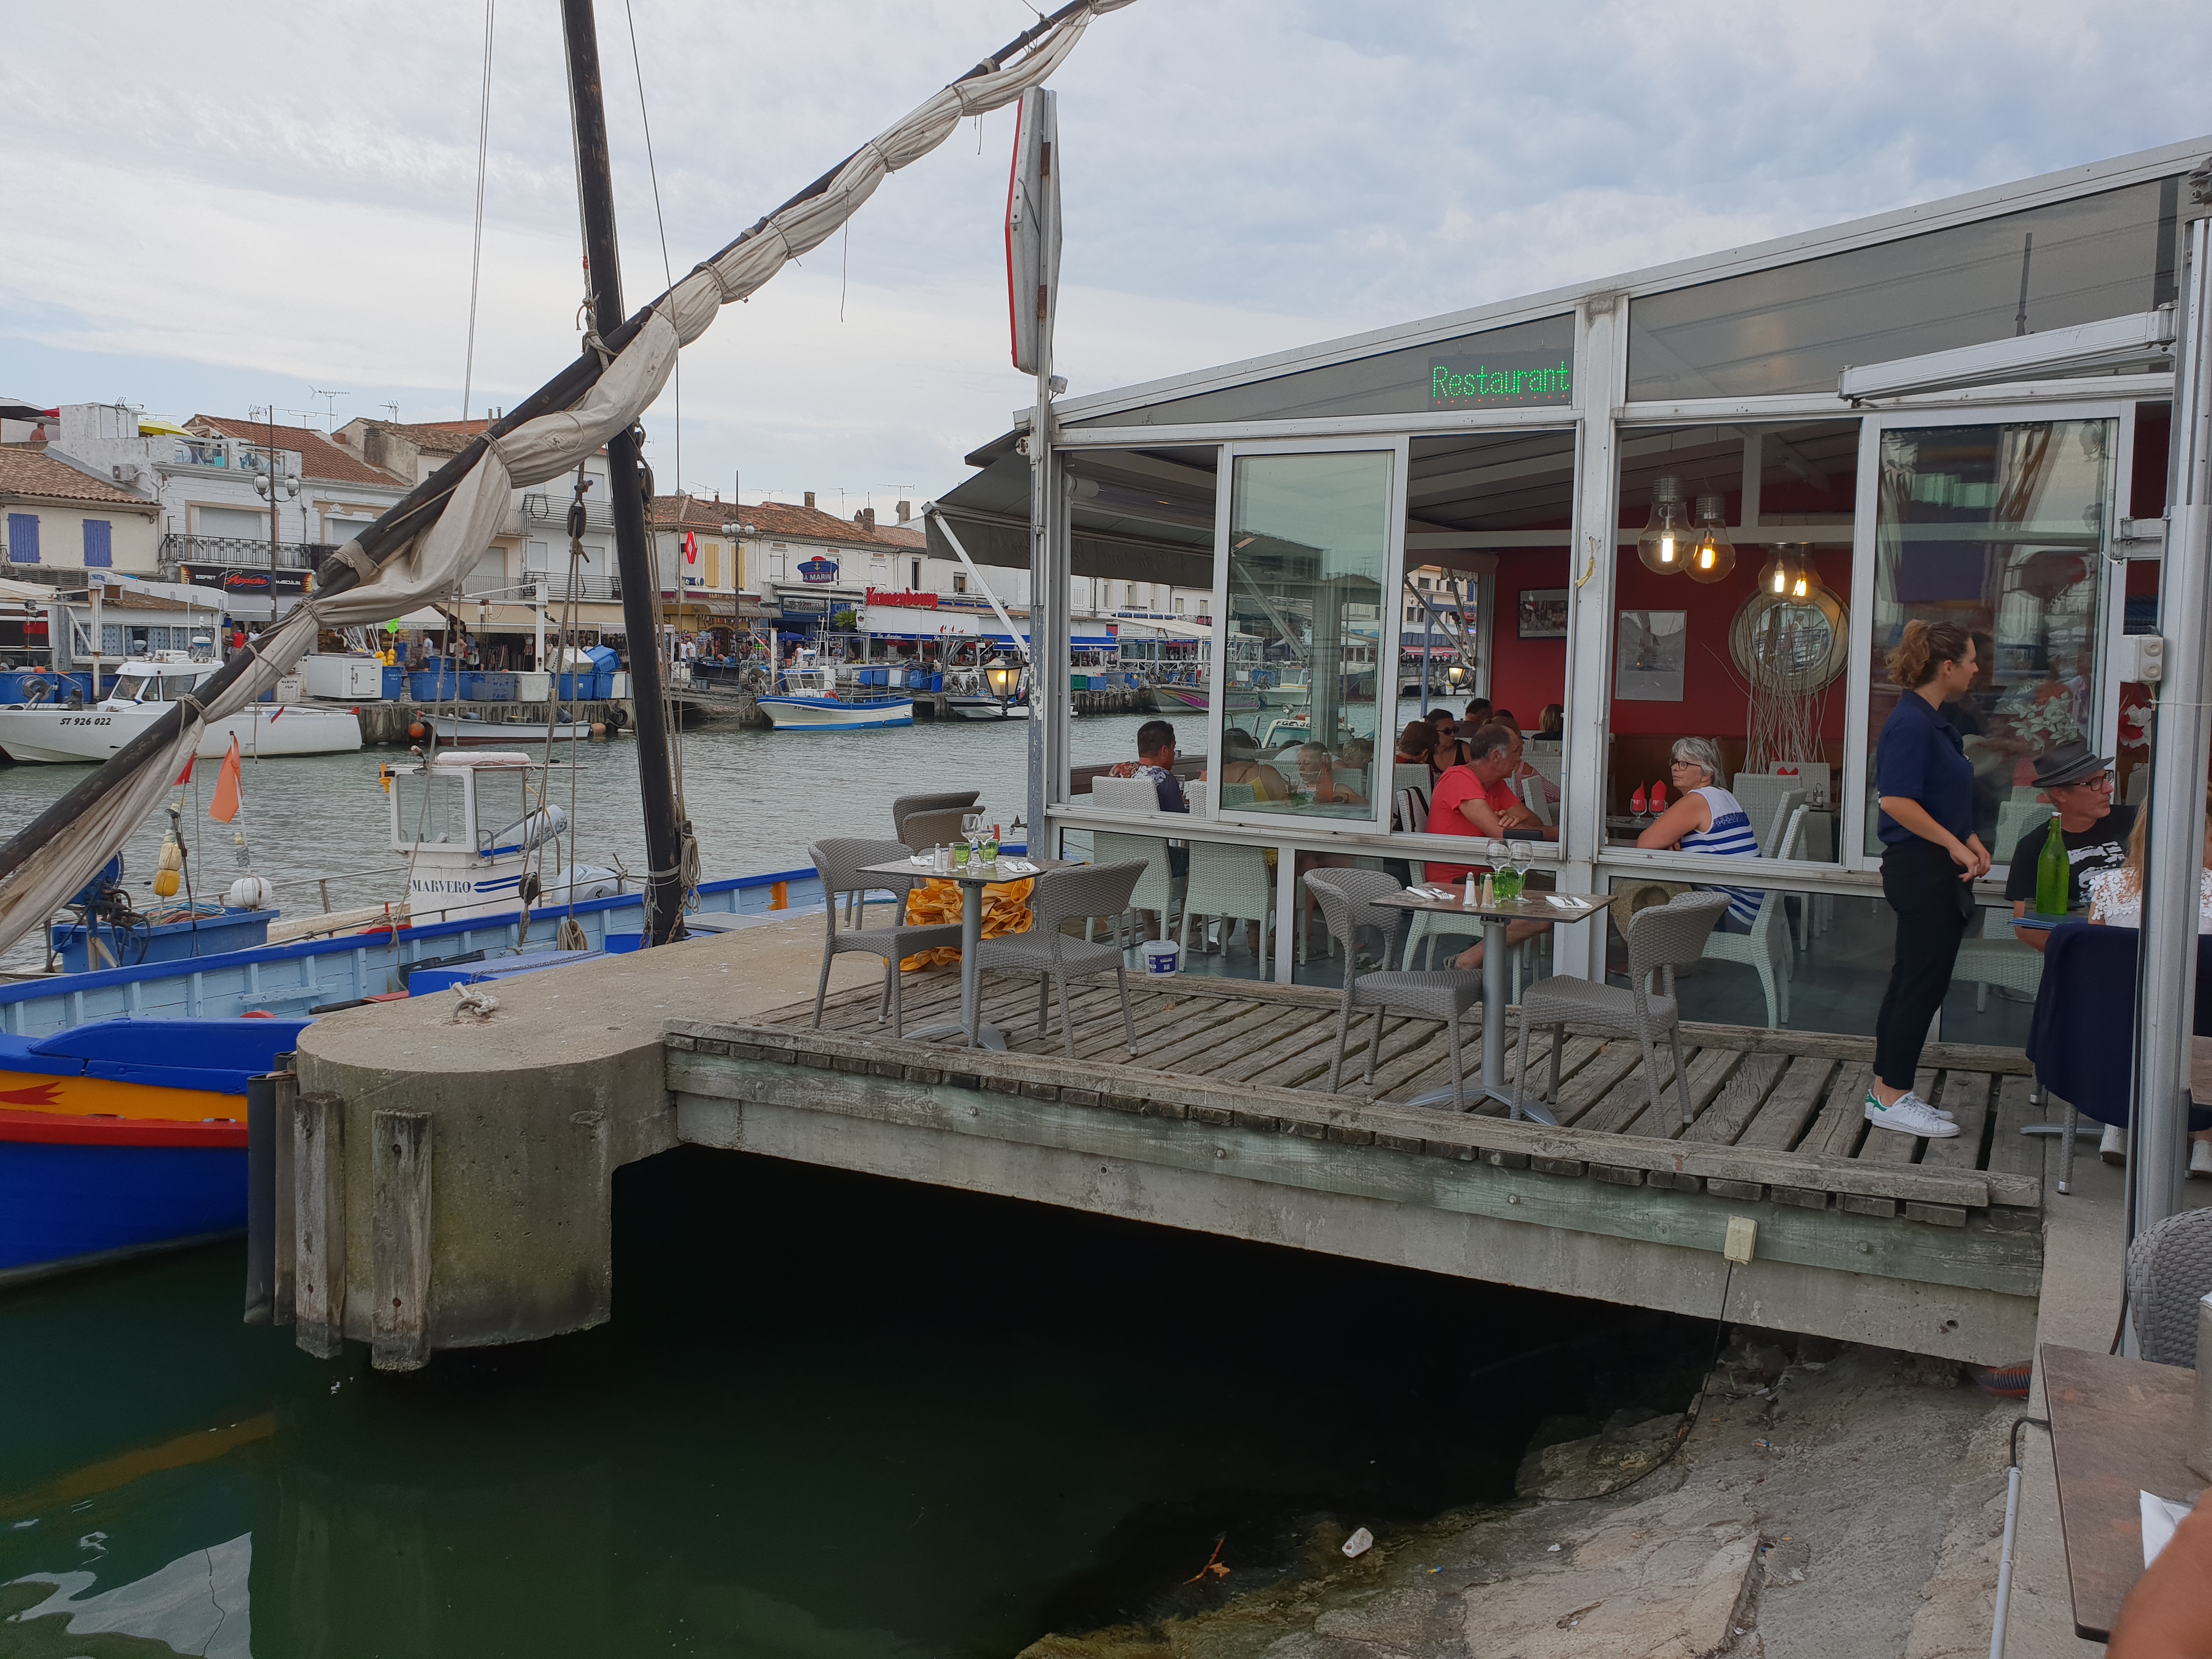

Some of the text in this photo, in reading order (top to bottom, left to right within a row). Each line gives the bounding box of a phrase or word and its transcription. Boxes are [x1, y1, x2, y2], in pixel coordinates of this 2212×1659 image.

[1433, 360, 1570, 397] Restaurant
[225, 574, 268, 585] Apache
[866, 587, 938, 610] Kronenbourg
[834, 603, 850, 613] CAF
[413, 879, 471, 893] MARVERO
